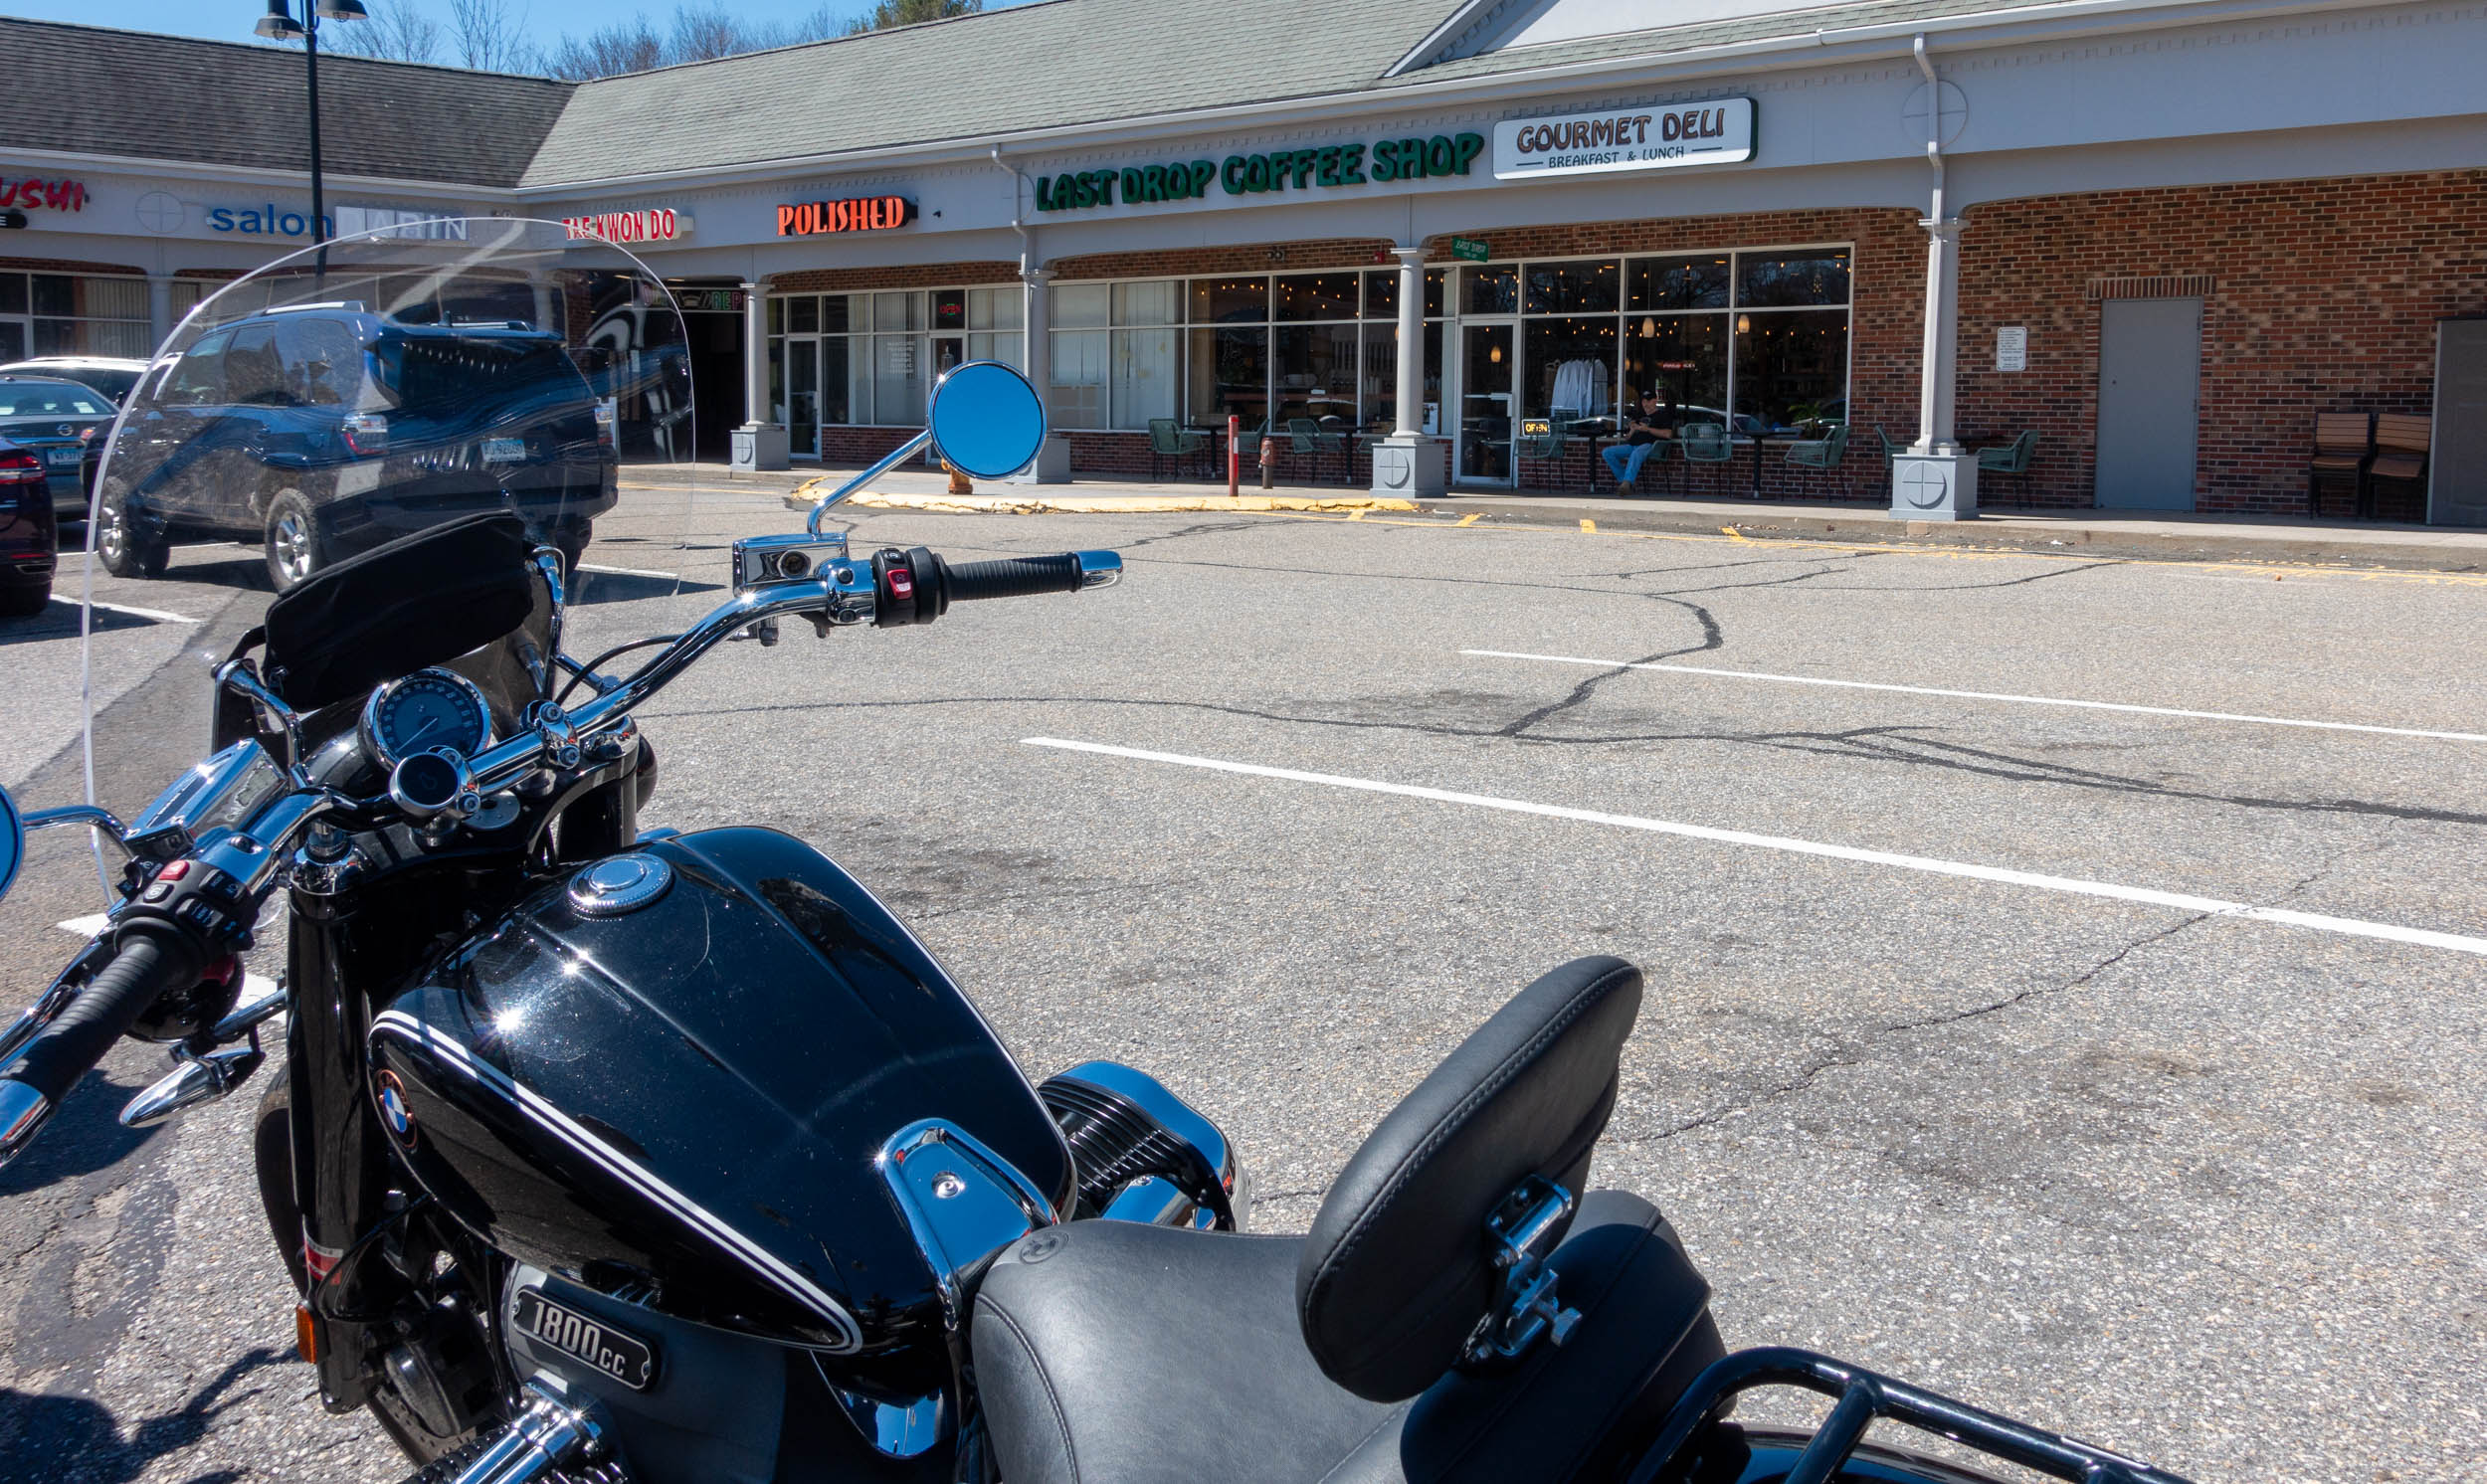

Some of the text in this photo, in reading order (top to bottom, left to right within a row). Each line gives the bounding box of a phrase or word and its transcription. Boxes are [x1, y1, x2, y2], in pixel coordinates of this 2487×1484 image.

[1517, 107, 1725, 153] GOURMET DELI
[1037, 132, 1484, 211] LAST DROP COFFEE SHOP
[1549, 146, 1684, 168] BREAKFAST & LUNCH
[211, 204, 333, 238] salon
[562, 208, 675, 243] TAE KWON DO
[778, 196, 904, 236] POLISHED
